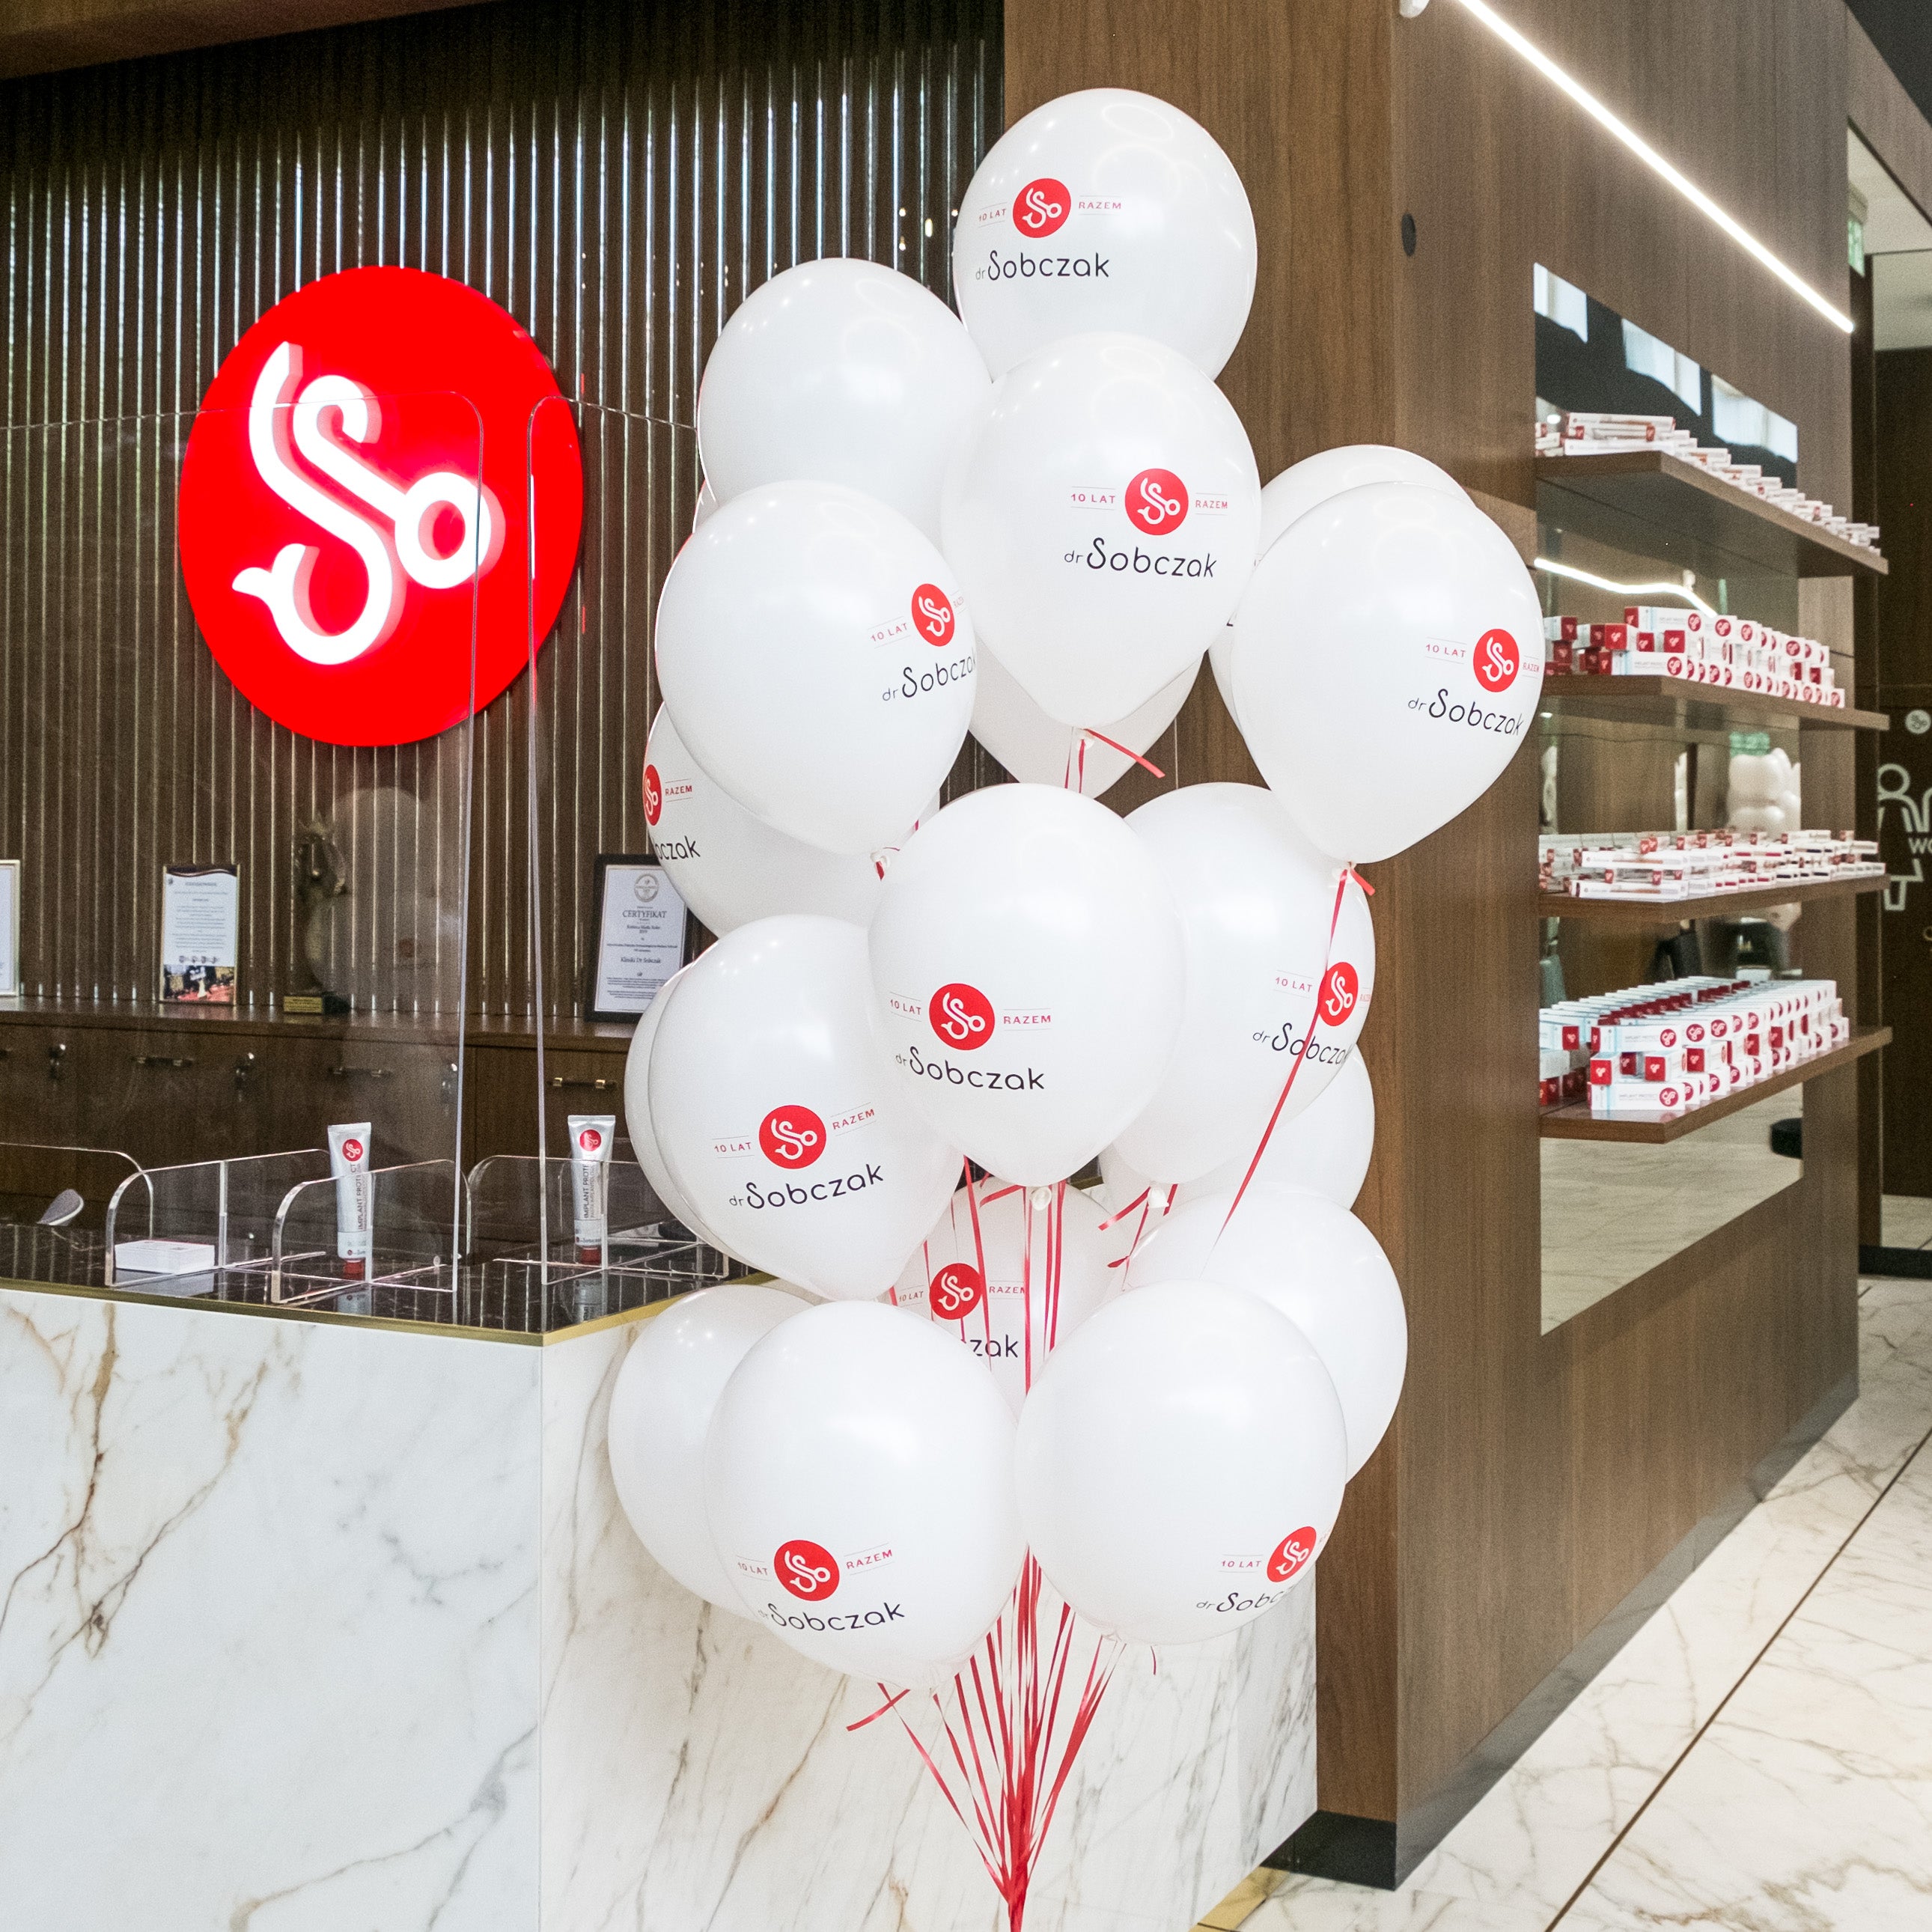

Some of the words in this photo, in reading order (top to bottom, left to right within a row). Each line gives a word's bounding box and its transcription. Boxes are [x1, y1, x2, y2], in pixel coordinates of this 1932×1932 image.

[989, 208, 1007, 219] LAT
[1078, 201, 1122, 210] RAZEM
[987, 250, 1110, 281] Sobczak
[1070, 493, 1085, 502] 10
[1091, 494, 1115, 504] LAT
[1195, 499, 1228, 509] RAZEM
[1064, 550, 1083, 564] dr
[1087, 537, 1217, 577] Sobczak
[871, 631, 884, 642] 10
[888, 622, 908, 636] LAT
[1425, 644, 1439, 653] 10
[1445, 646, 1466, 658] LAT
[882, 688, 898, 701] dr
[1408, 698, 1427, 711] dr
[1429, 688, 1524, 736] Sobczak
[665, 785, 692, 796] RAZEM
[622, 909, 668, 918] CERTYFIKAT
[1276, 977, 1288, 987] 10
[1292, 981, 1313, 993] LAT
[890, 999, 900, 1010] 10
[903, 1003, 921, 1015] LAT
[1003, 1014, 1052, 1025] RAZEM
[1252, 1030, 1271, 1043] dr
[909, 1046, 1045, 1090] Sobczak
[714, 1143, 728, 1153] 10
[731, 1142, 752, 1152] LAT
[832, 1109, 875, 1130] RAZEM
[729, 1195, 744, 1207] dr
[746, 1163, 884, 1210] Sobczak
[909, 1290, 924, 1300] LAT
[750, 1564, 769, 1576] LAT
[846, 1549, 893, 1570] RAZEM
[768, 1602, 905, 1631] Sobczak
